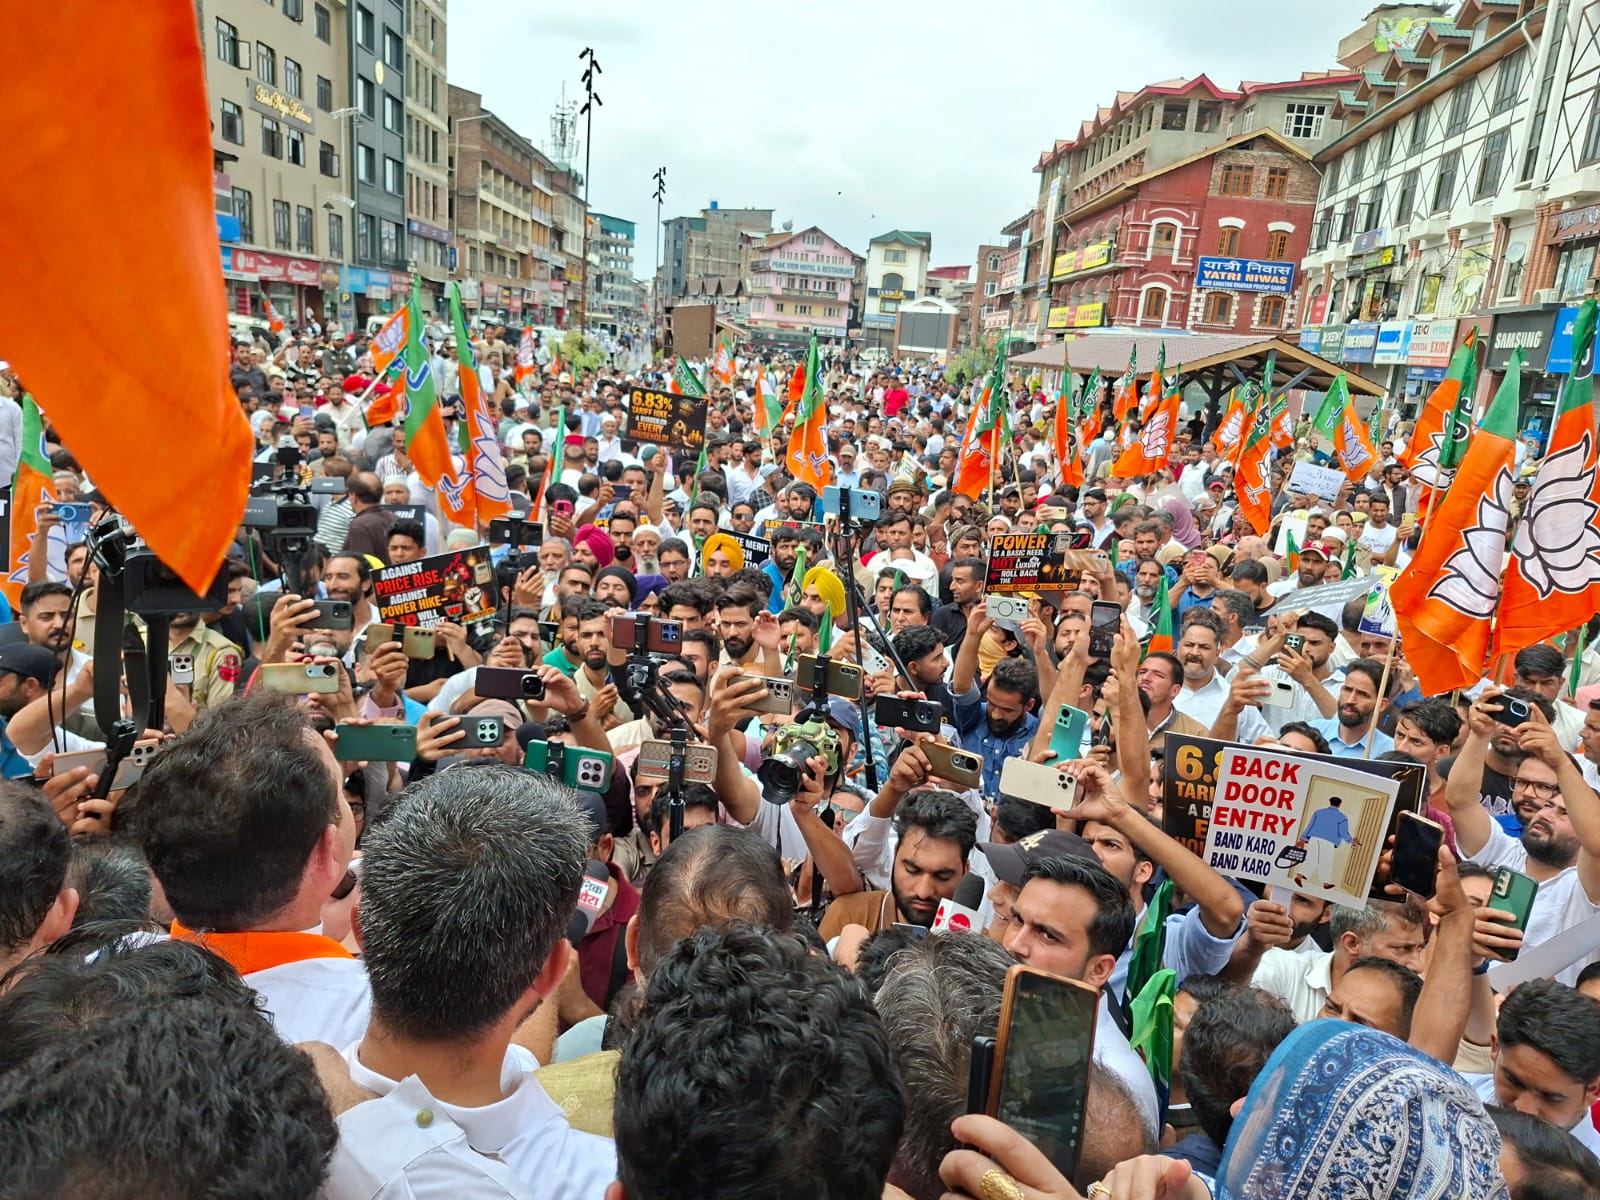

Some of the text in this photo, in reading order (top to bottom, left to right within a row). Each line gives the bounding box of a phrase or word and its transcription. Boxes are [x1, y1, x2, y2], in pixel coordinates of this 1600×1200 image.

[800, 263, 816, 272] HOTEL
[1203, 260, 1292, 275] यात्री निवास
[1203, 270, 1288, 284] YATRI NIWAS
[1494, 330, 1543, 349] SAMSUNG
[632, 390, 673, 411] 6.83%
[631, 405, 653, 416] TARIFF
[637, 421, 664, 434] EVERY
[745, 538, 769, 553] MERIT
[993, 534, 1048, 550] POWER
[1006, 549, 1026, 557] BASIC
[381, 561, 424, 580] AGAINST
[991, 557, 1017, 569] NOT
[1001, 569, 1039, 577] ROLL BACK
[375, 575, 411, 595] PRICE
[390, 588, 428, 605] AGAINST
[380, 602, 417, 619] POWER
[417, 608, 440, 621] WILL
[1230, 755, 1302, 785] BACK
[1224, 781, 1296, 811] DOOR
[1187, 803, 1198, 817] A
[1213, 806, 1297, 837] ENTRY
[1214, 830, 1276, 856] BAND KARO
[1210, 851, 1271, 877] BAND KARO
